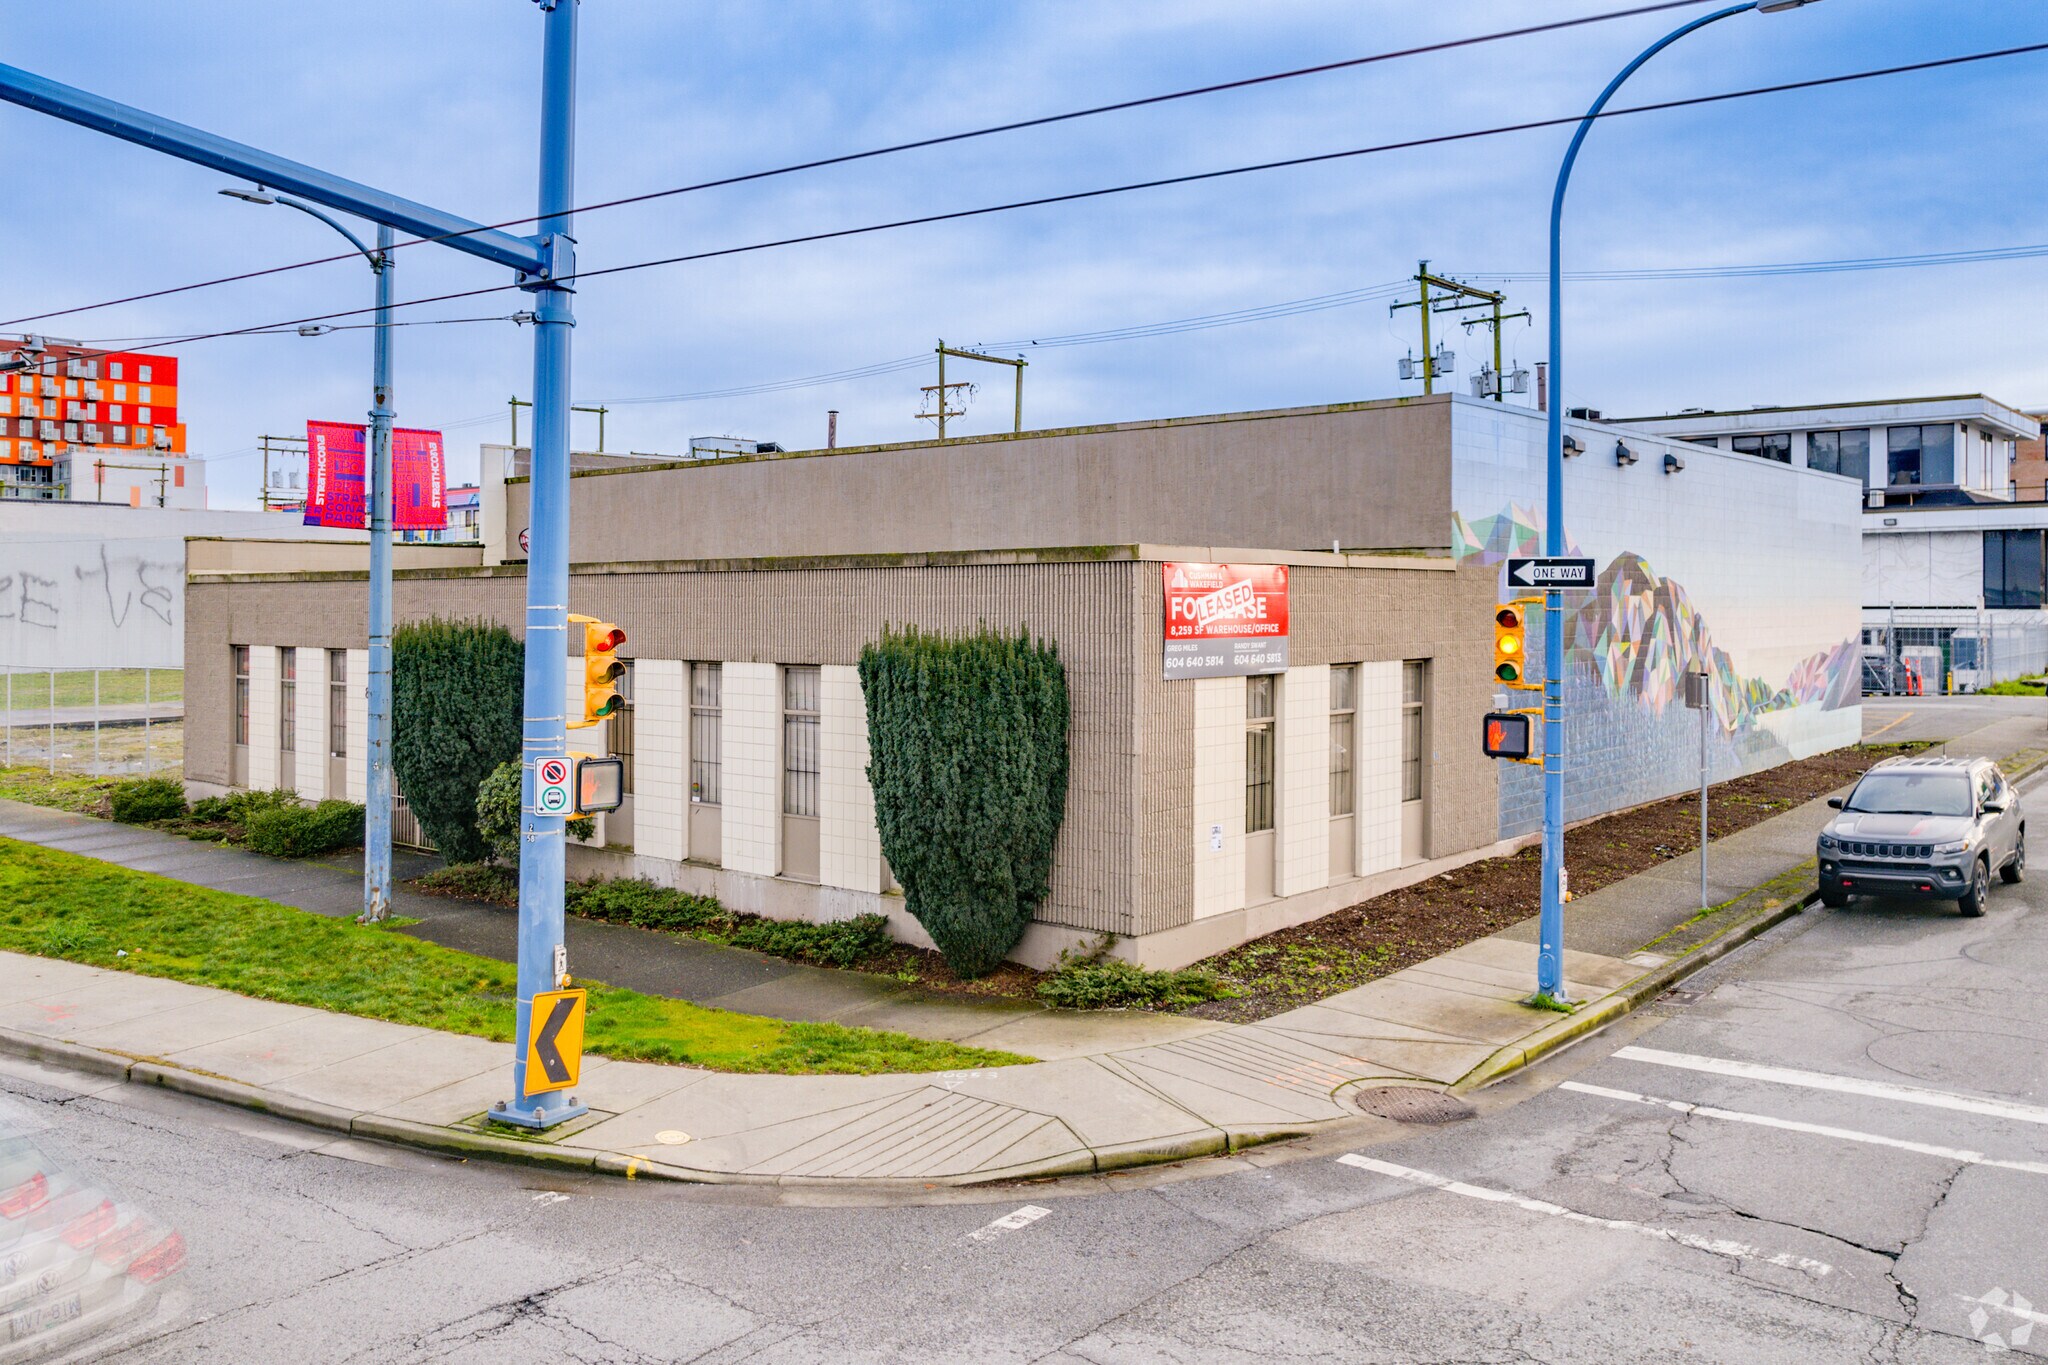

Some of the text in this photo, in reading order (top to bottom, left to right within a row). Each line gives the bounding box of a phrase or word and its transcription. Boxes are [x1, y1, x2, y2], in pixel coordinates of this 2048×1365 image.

[325, 512, 365, 525] PARK
[1533, 567, 1584, 578] ONE WAY
[1189, 580, 1223, 589] WAKEFIELD
[1171, 597, 1198, 620] FO
[1198, 585, 1252, 621] LEASED
[1171, 623, 1279, 637] 8,259 SF WAREHOUSE/OFFICE
[1182, 644, 1198, 652] MILES
[1166, 655, 1224, 669] 604 640 5814
[1234, 652, 1282, 665] 604 640 5813
